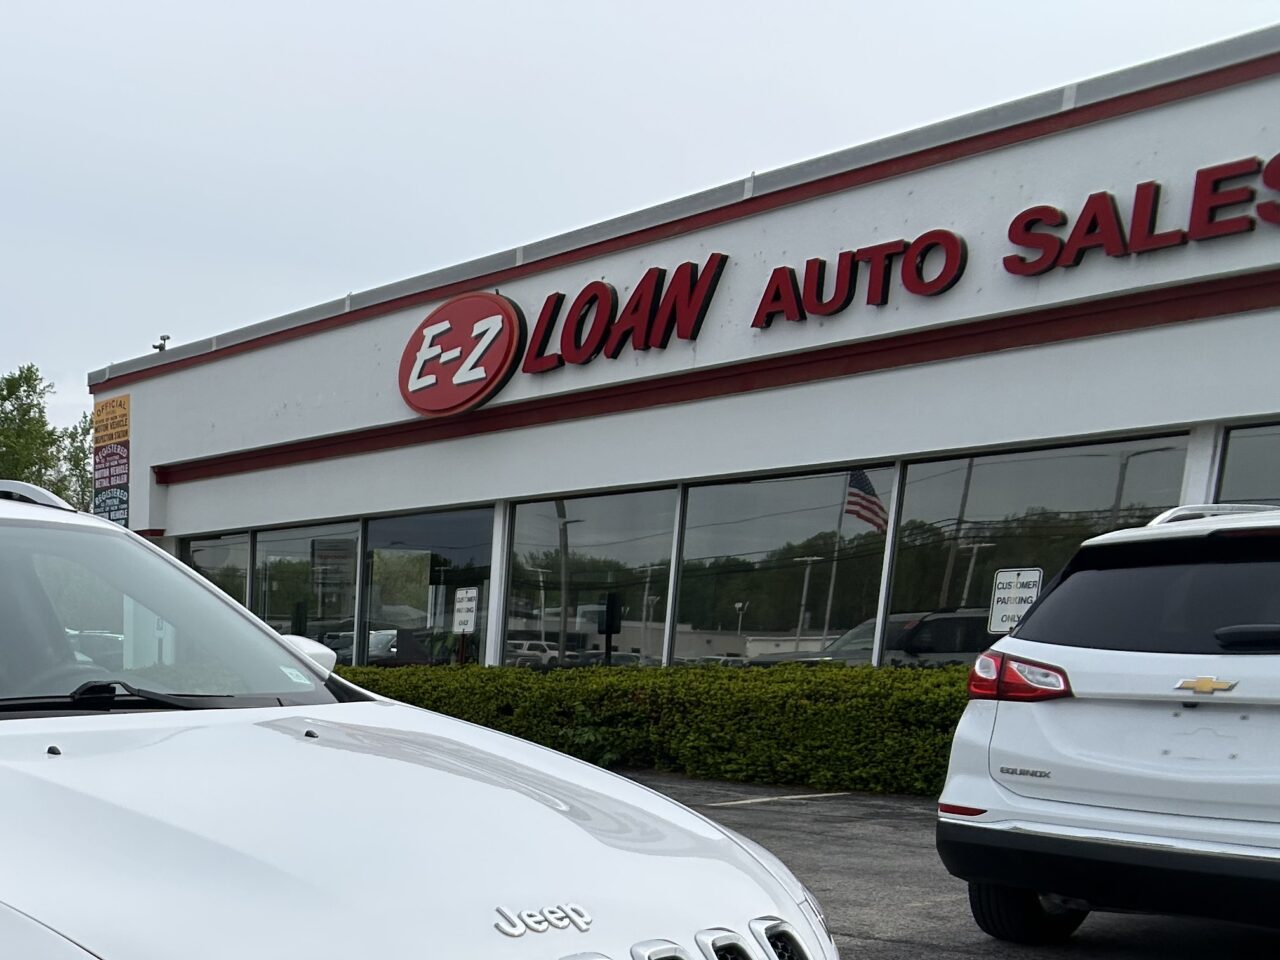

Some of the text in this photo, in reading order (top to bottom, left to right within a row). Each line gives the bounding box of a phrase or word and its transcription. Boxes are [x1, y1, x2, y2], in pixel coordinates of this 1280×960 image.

[407, 314, 504, 392] E-Z
[521, 251, 729, 374] LOAN
[750, 228, 968, 329] AUTO
[96, 399, 127, 417] OFFICIAL
[110, 418, 128, 430] VEHICLE
[95, 444, 128, 464] REGISTERED
[95, 488, 128, 506] REGISTERED
[996, 580, 1038, 591] CUSTOMER
[996, 595, 1034, 605] PARKING
[1000, 614, 1022, 623] ONLY
[1000, 766, 1052, 779] EQUINOX
[494, 903, 592, 938] Jeep
